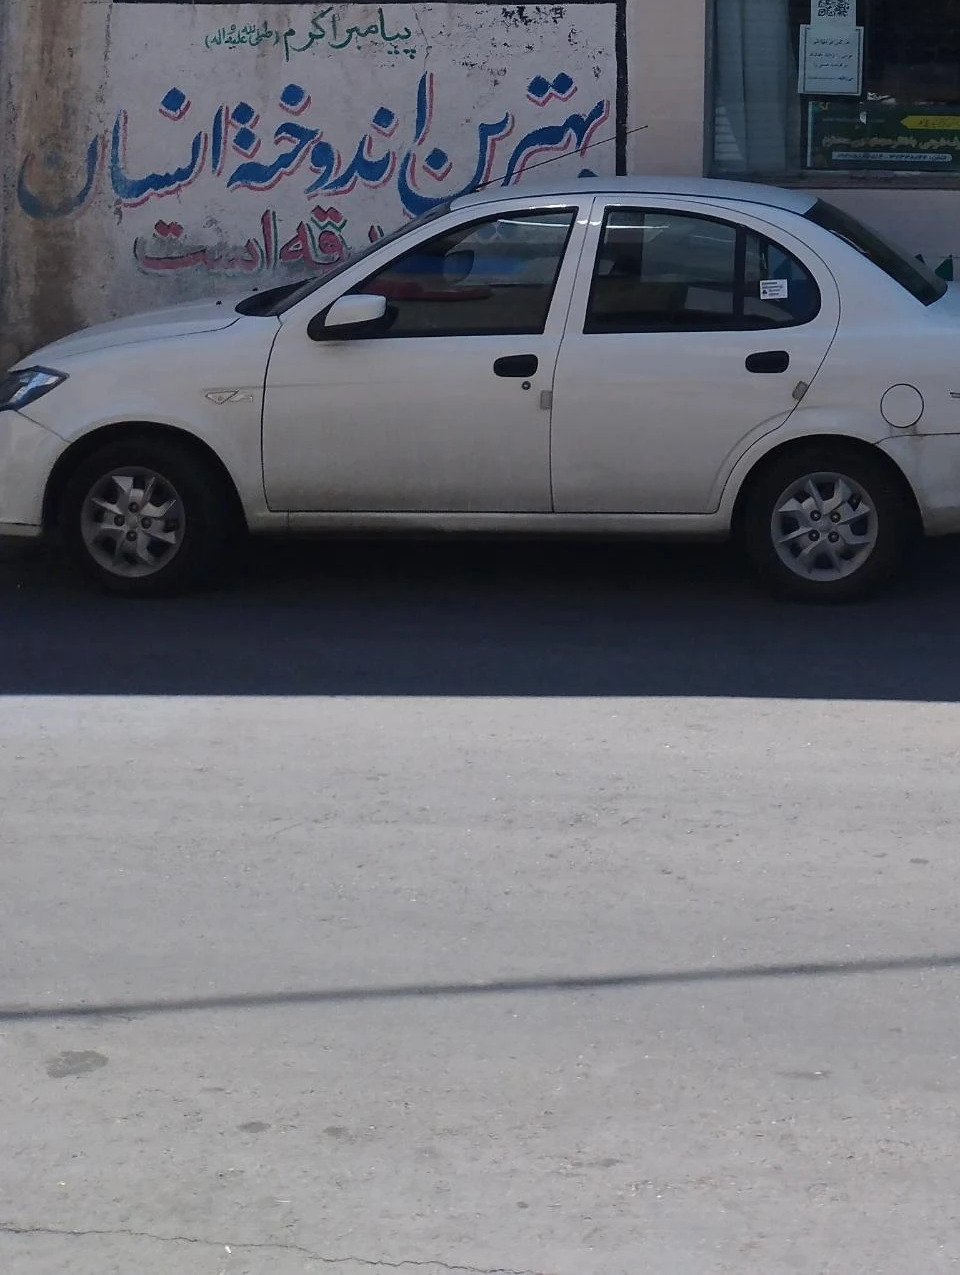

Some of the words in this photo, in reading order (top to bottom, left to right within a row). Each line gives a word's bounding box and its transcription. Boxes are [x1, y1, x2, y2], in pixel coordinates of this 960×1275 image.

[283, 6, 338, 63] اکرم
[328, 7, 417, 60] پیامبر
[17, 86, 231, 220] انسان
